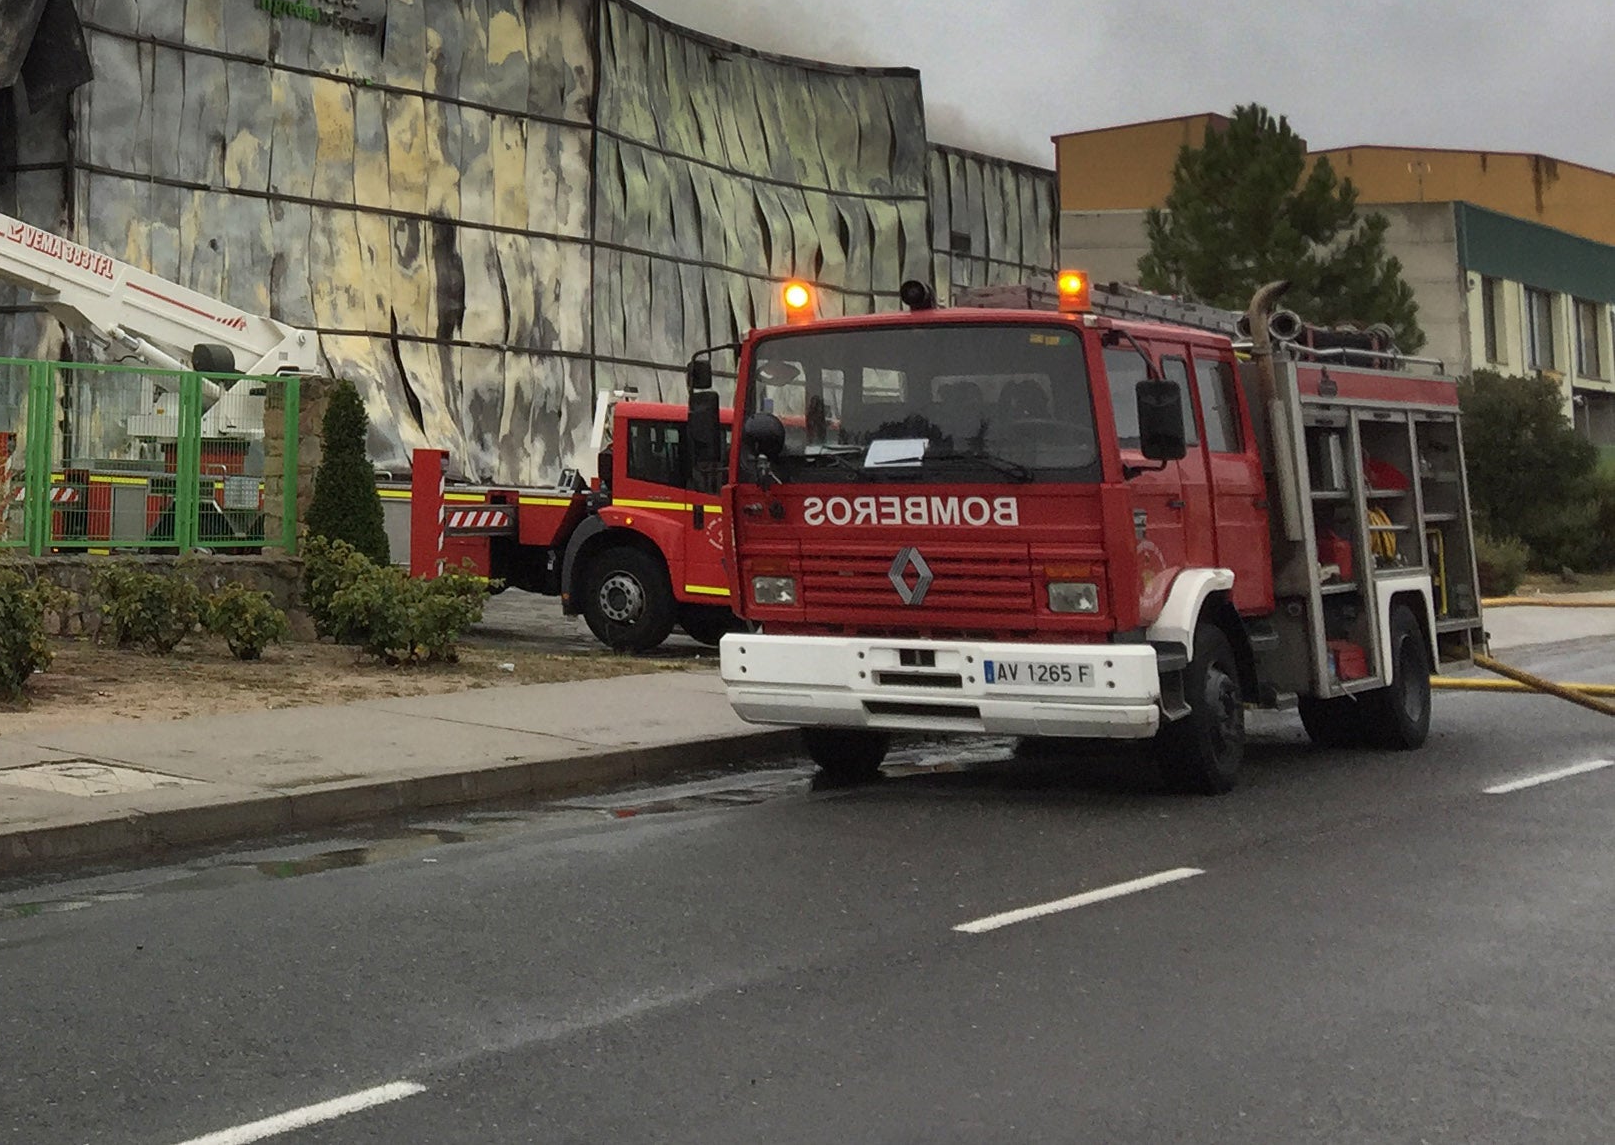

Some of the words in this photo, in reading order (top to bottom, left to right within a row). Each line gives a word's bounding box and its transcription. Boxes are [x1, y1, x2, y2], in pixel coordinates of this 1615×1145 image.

[26, 228, 63, 260] VEMA
[997, 663, 1018, 682] AV
[1028, 664, 1072, 683] 1265
[1079, 665, 1090, 683] F
